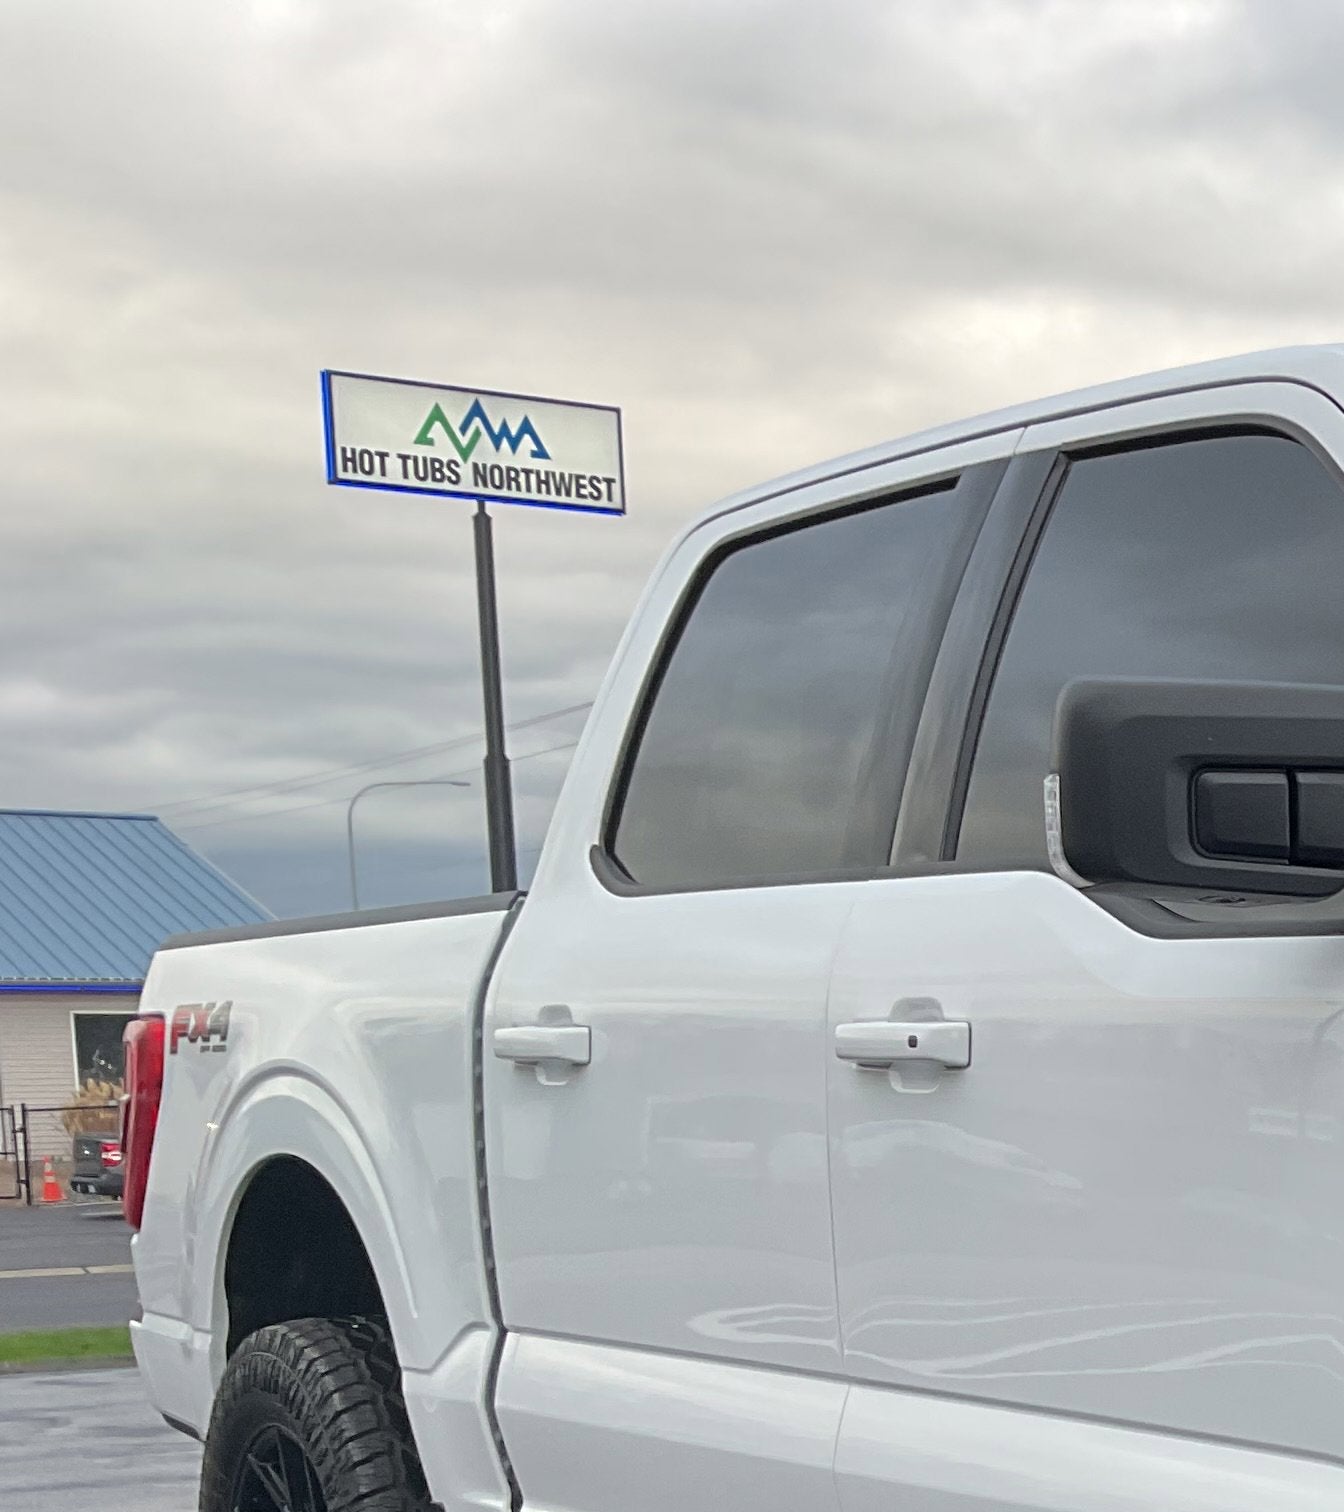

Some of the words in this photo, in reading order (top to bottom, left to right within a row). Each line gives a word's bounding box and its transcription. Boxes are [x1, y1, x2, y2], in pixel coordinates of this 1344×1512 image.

[340, 446, 390, 477] HOT
[397, 453, 462, 485] TUBS
[472, 461, 617, 503] NORTHWEST
[170, 1000, 233, 1055] FX4
